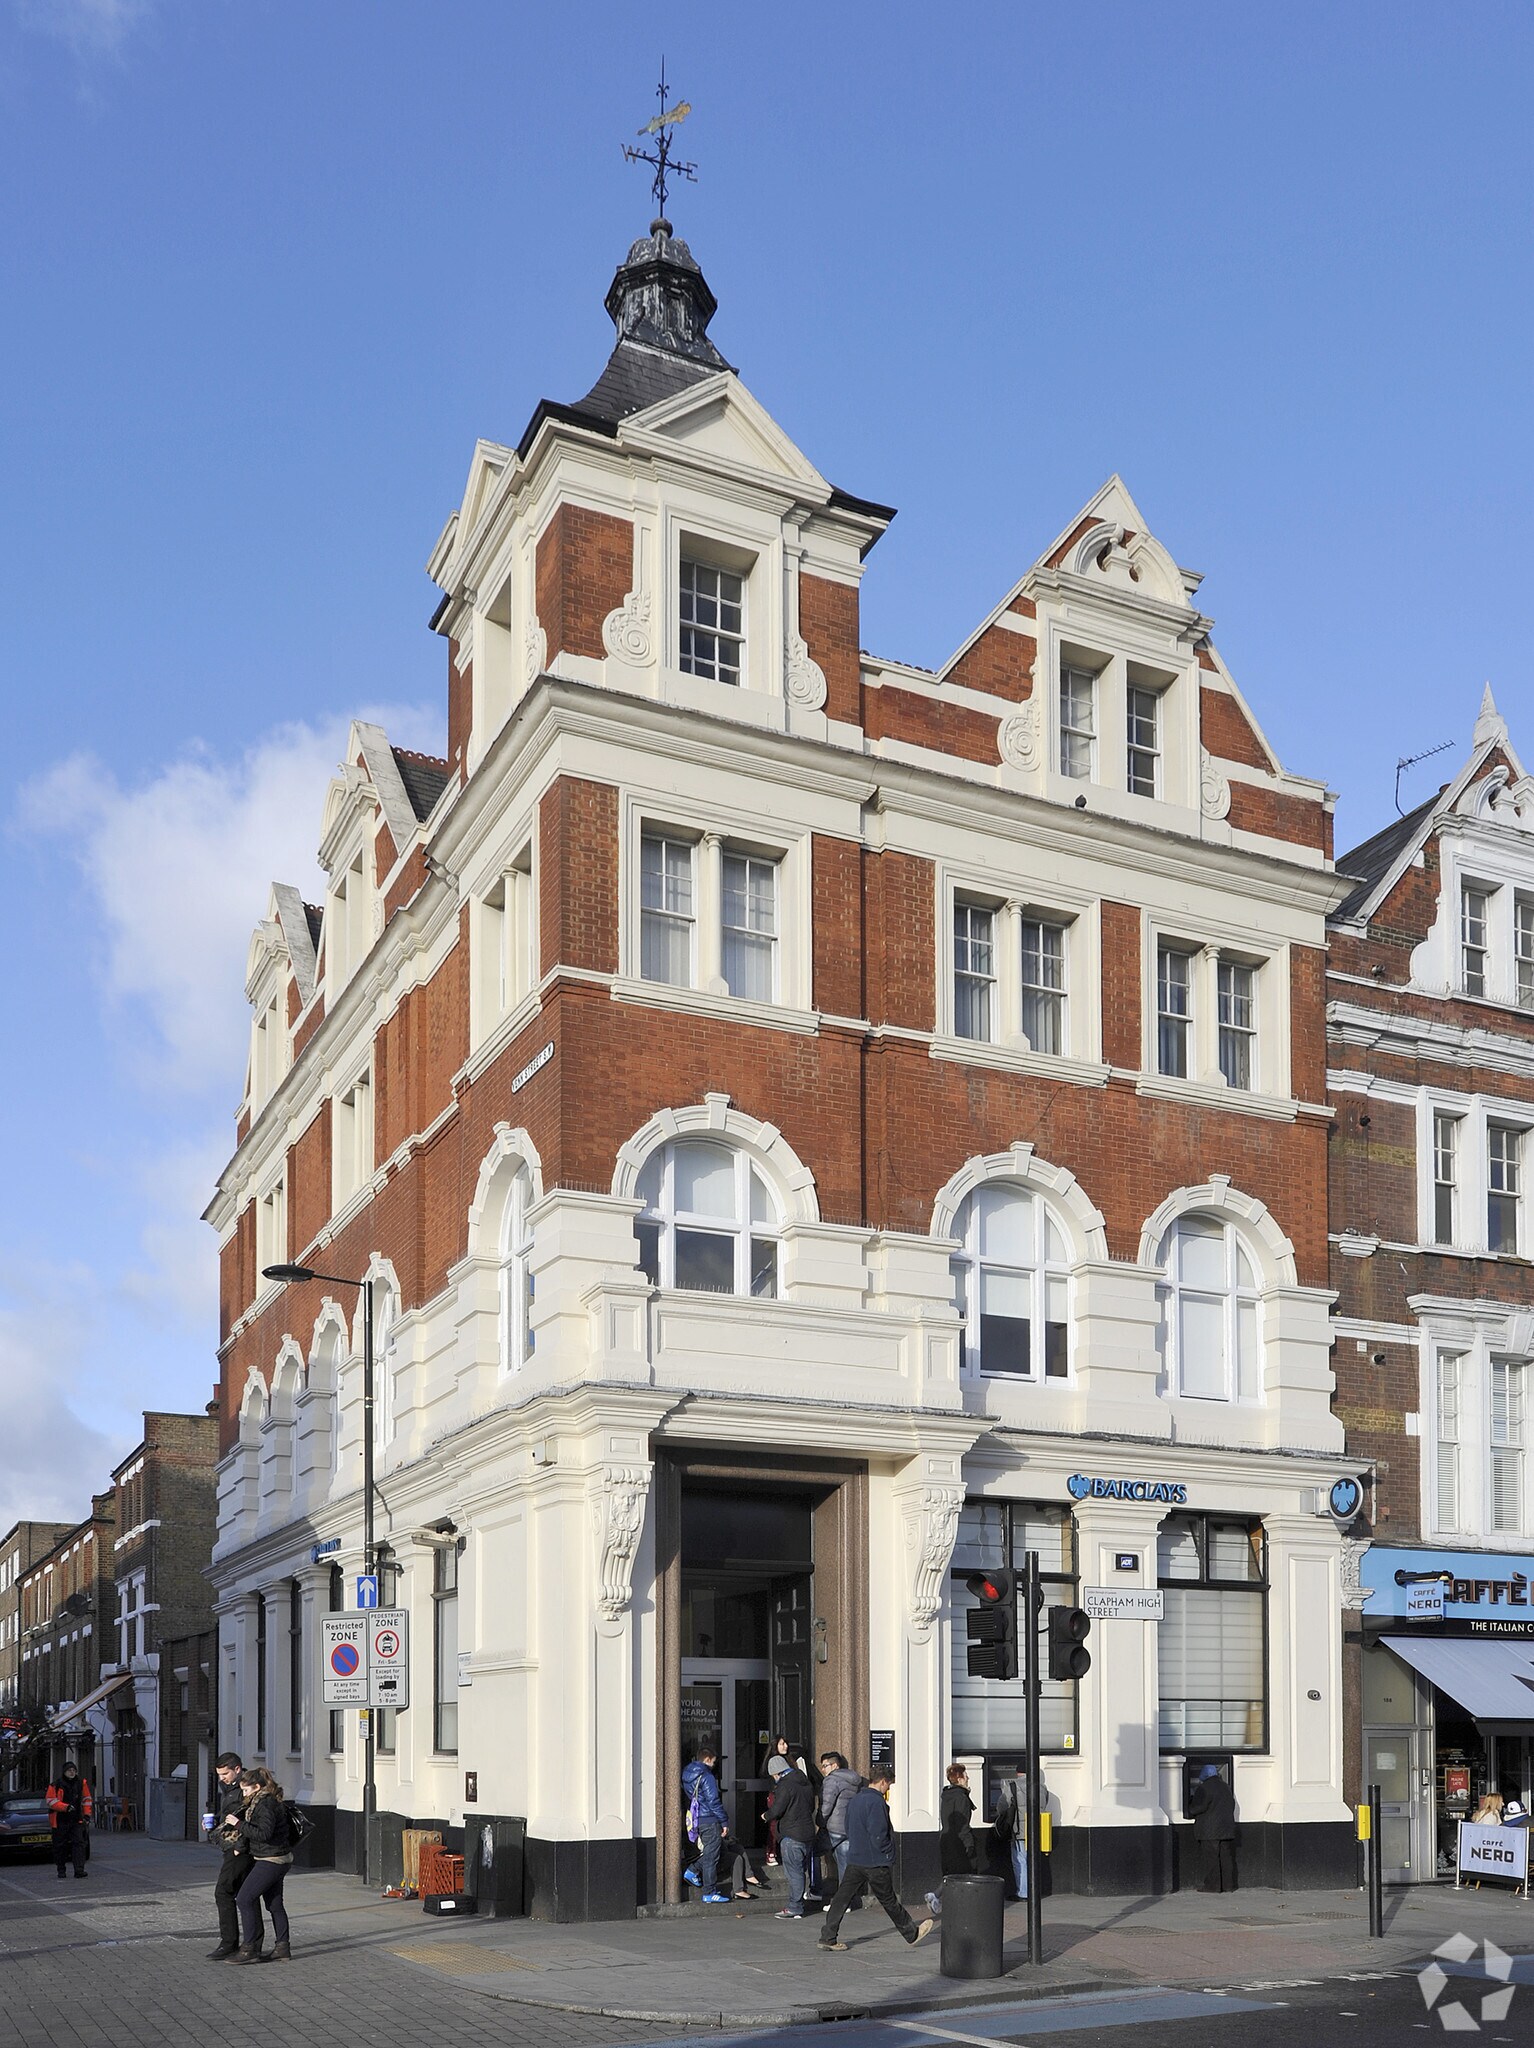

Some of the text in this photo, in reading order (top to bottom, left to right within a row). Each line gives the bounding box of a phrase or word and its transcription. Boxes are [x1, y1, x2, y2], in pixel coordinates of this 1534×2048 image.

[1092, 1478, 1187, 1504] BARCLAYS
[1088, 1596, 1160, 1608] CLAPHAM HIGH
[1408, 1600, 1441, 1610] NERO
[1088, 1606, 1119, 1616] STREET
[326, 1622, 364, 1630] Restricted
[376, 1619, 399, 1627] ZONE
[1470, 1622, 1534, 1633] THE ITALIAN C
[331, 1632, 358, 1641] ZONE
[681, 1708, 707, 1716] HEARD
[1470, 1846, 1514, 1863] NERO
